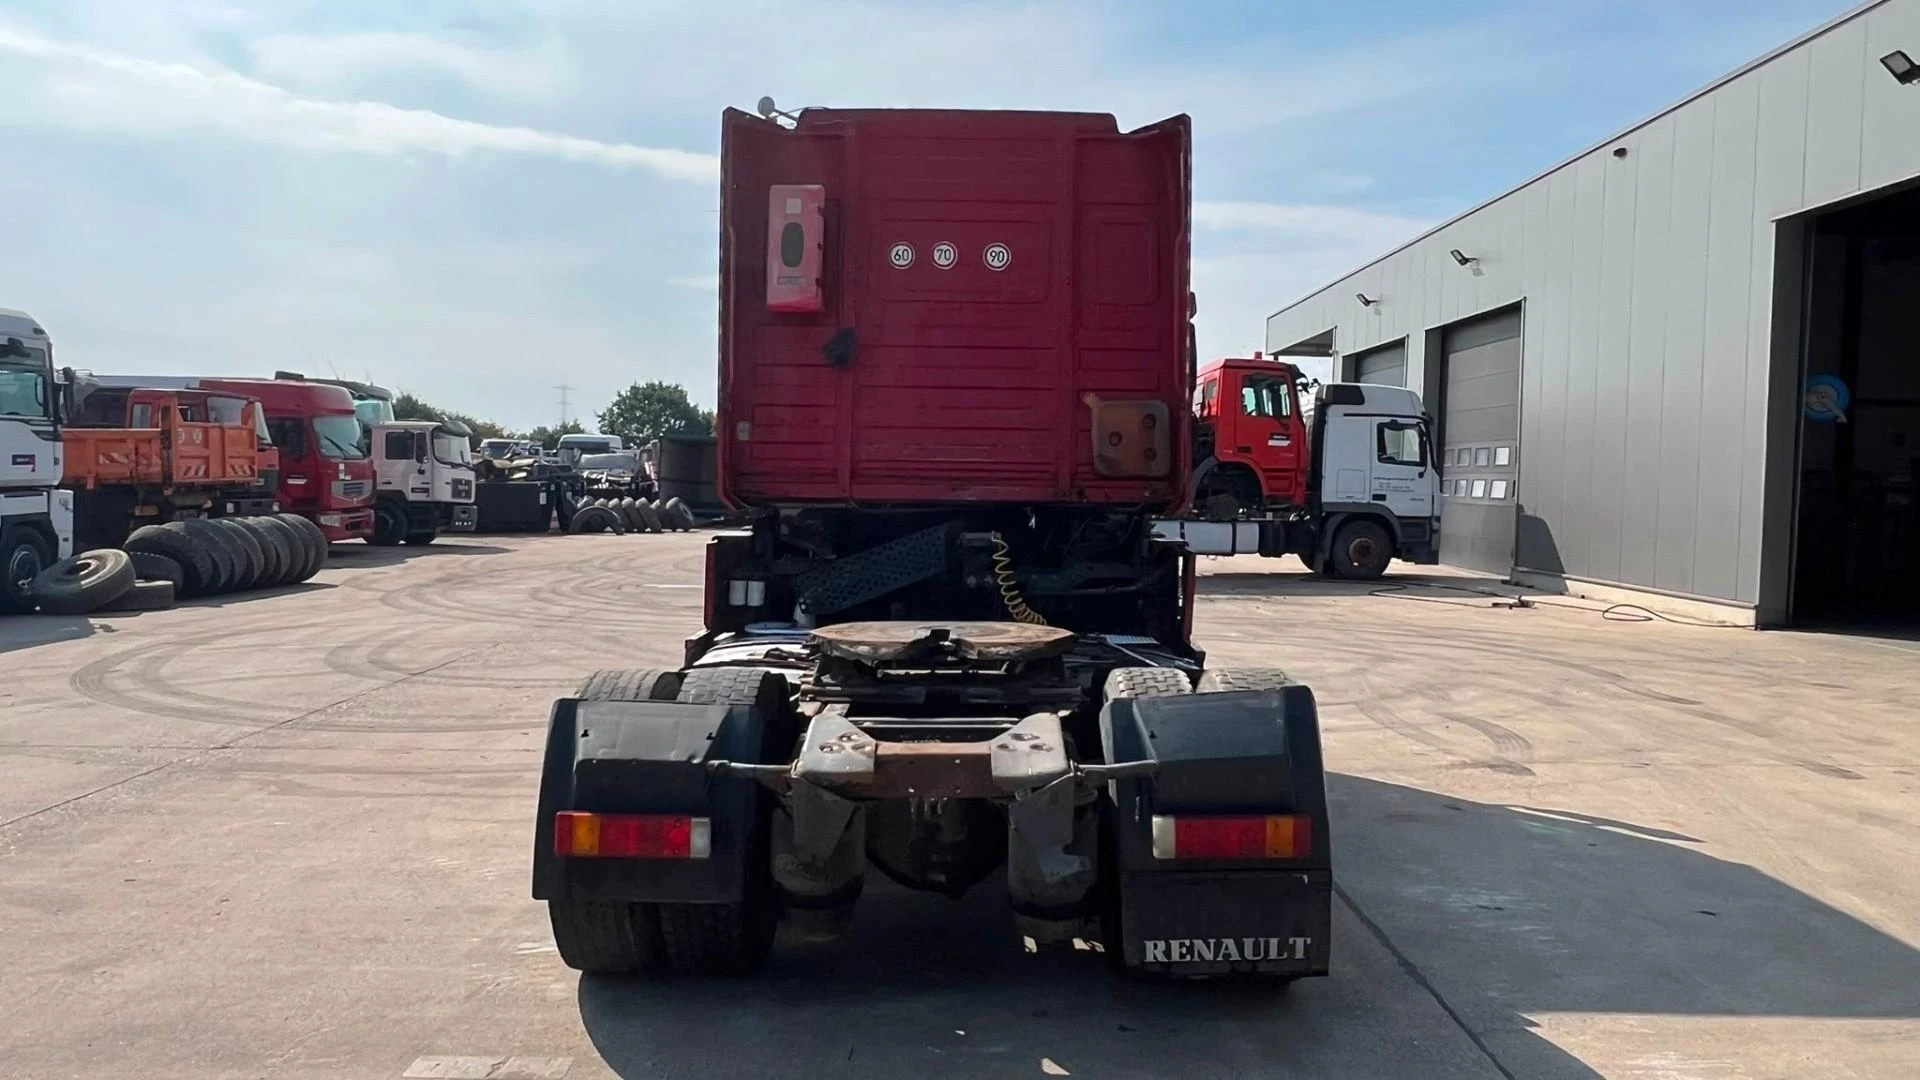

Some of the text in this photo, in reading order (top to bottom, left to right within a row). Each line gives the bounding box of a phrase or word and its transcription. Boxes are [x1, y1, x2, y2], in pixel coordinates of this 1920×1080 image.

[893, 248, 910, 262] 60
[936, 248, 952, 261] 70
[989, 249, 1005, 263] 90
[1143, 937, 1312, 963] RENAULT
